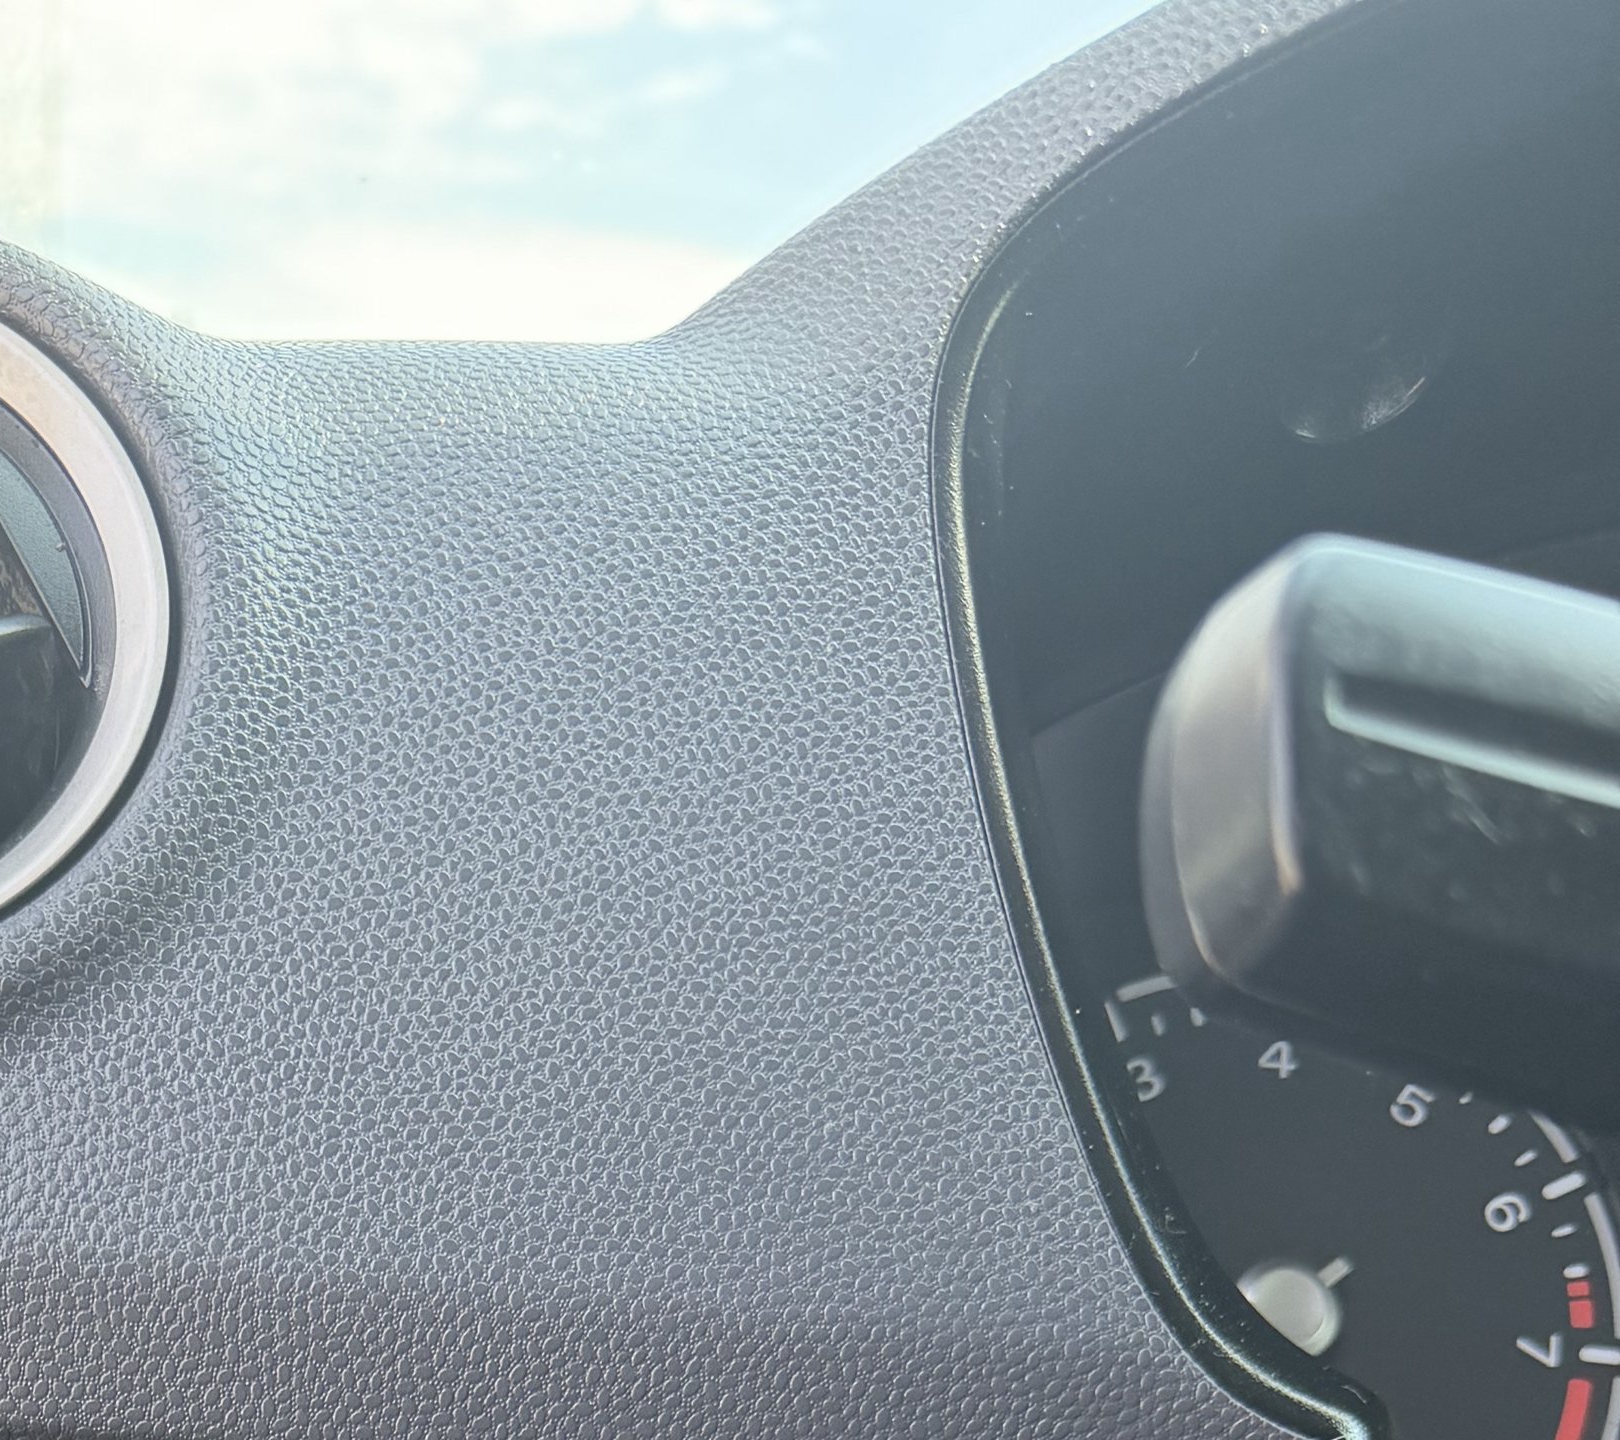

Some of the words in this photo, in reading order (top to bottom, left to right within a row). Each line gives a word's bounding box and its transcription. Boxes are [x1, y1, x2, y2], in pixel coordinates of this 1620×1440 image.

[1125, 1056, 1166, 1102] 3
[1257, 1041, 1298, 1079] 4
[1389, 1083, 1436, 1128] 5
[1484, 1191, 1532, 1233] 6
[1515, 1331, 1564, 1368] 7
